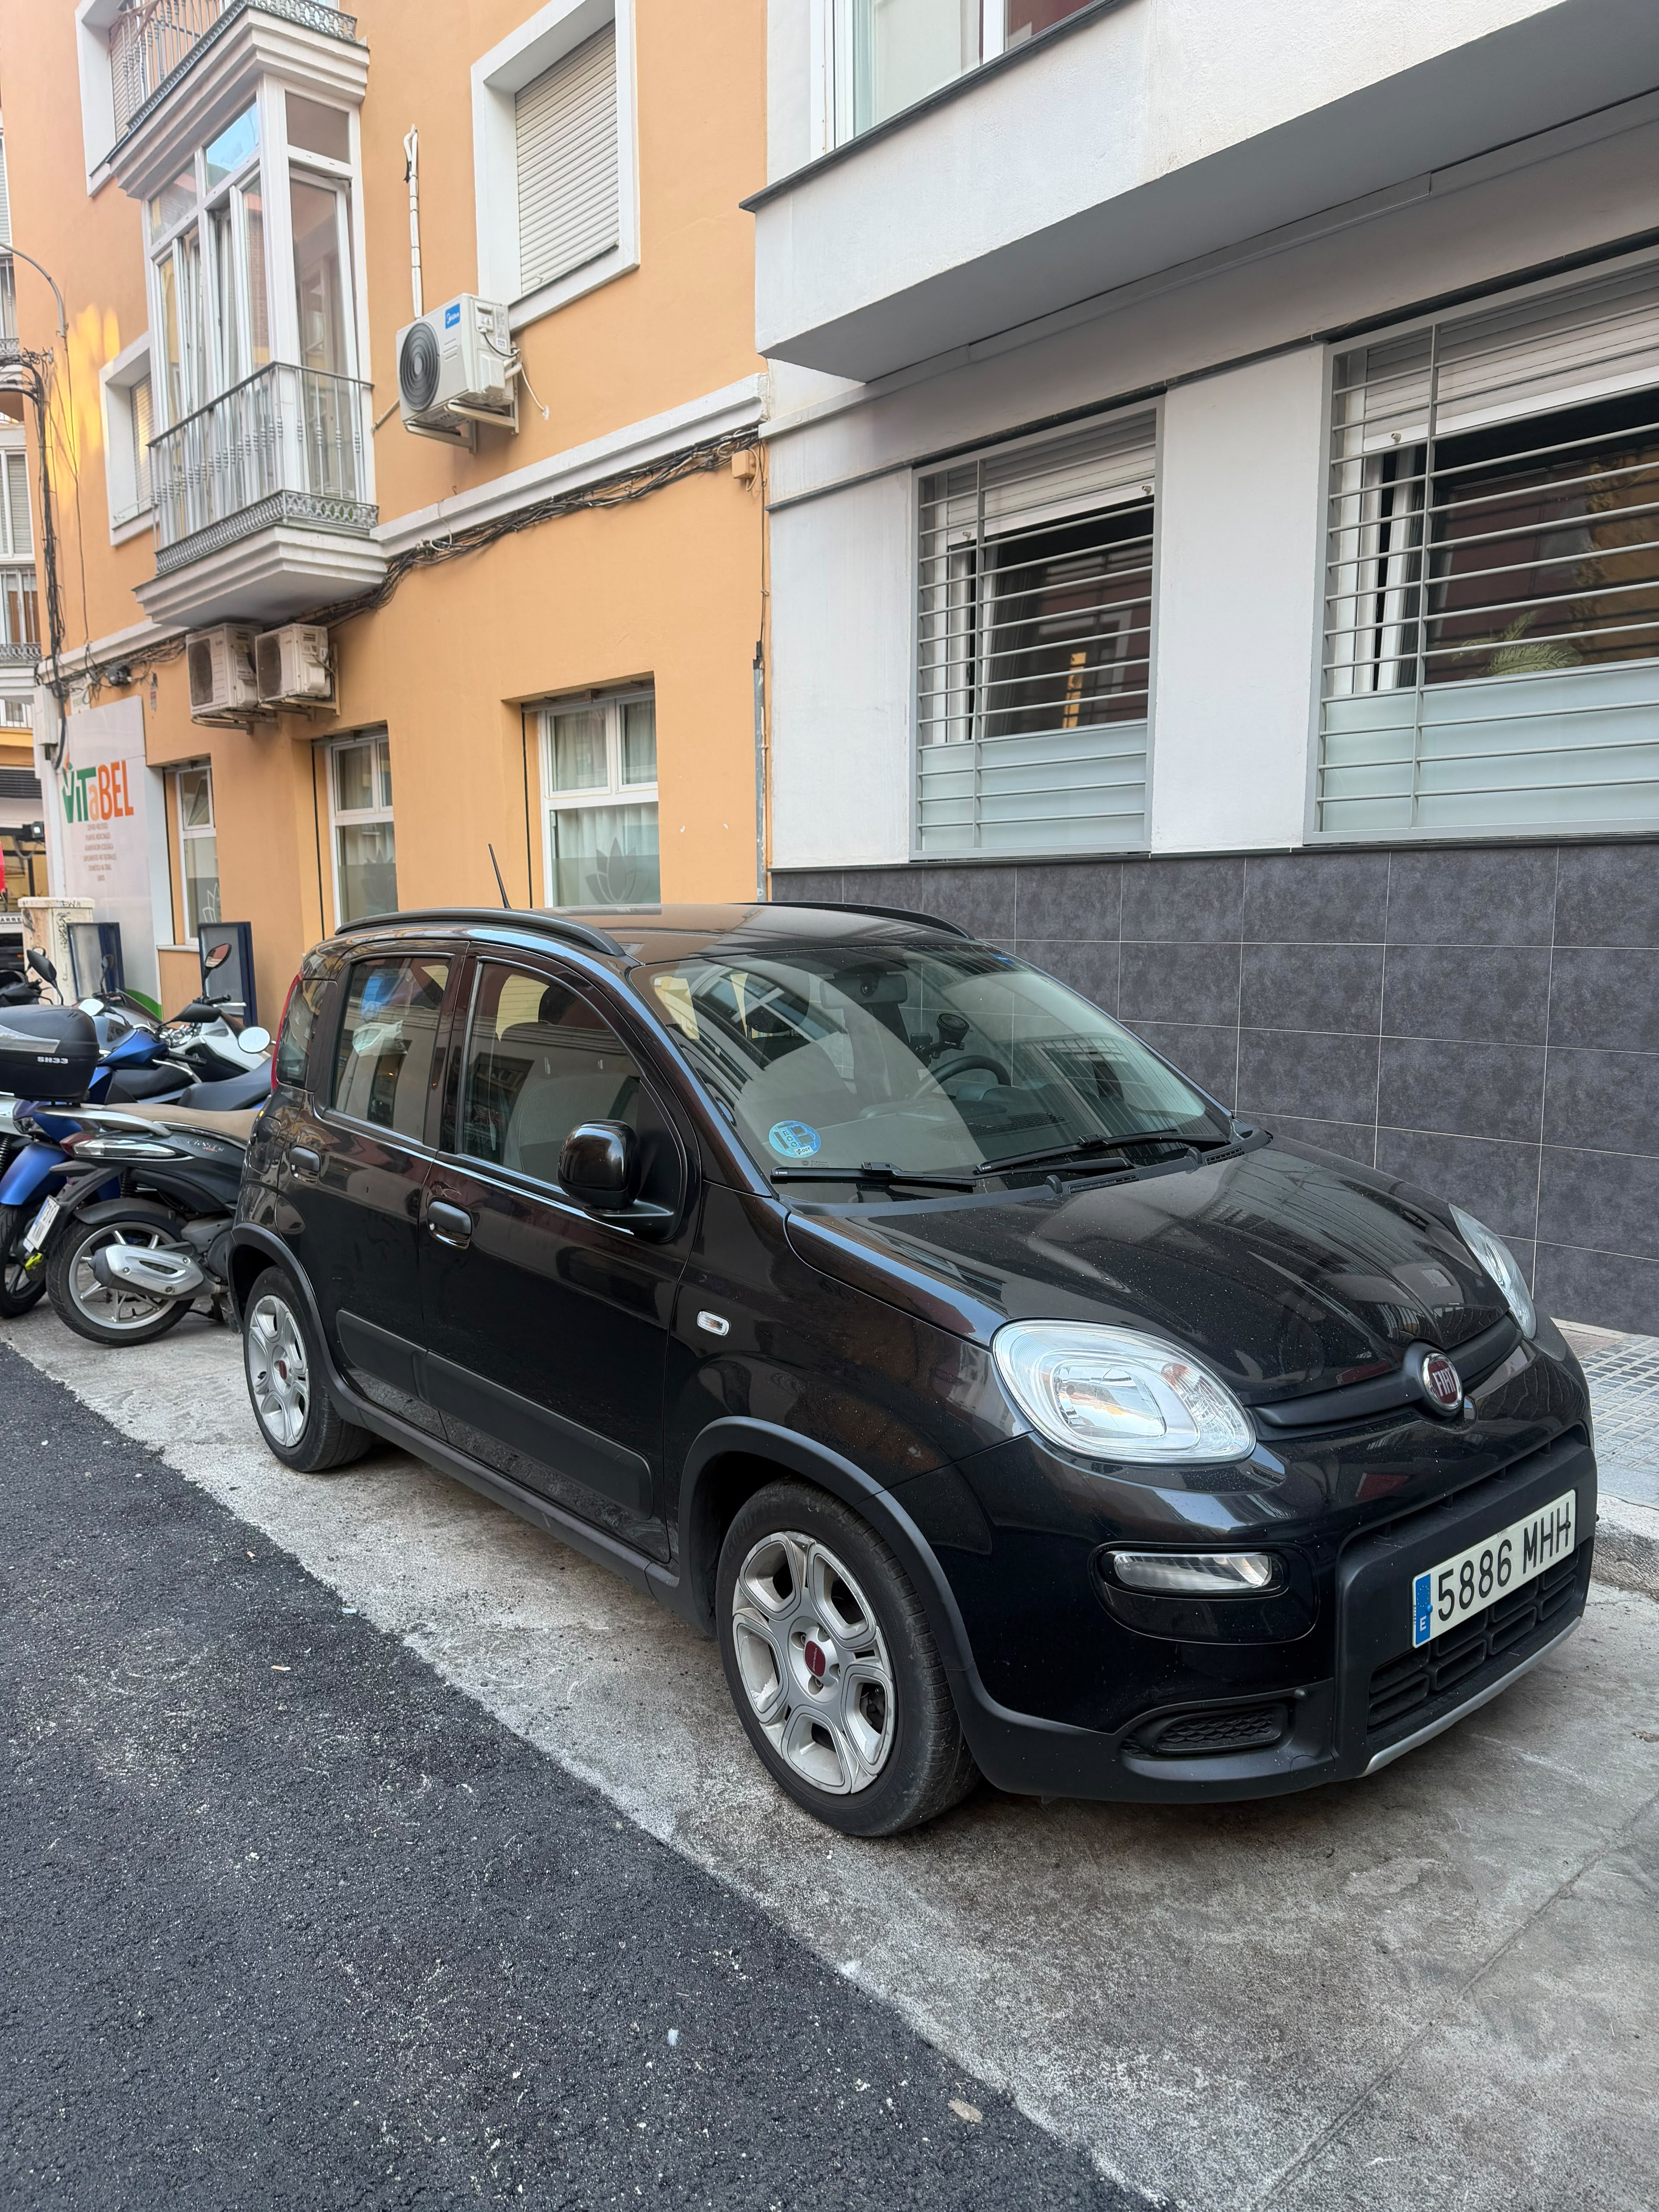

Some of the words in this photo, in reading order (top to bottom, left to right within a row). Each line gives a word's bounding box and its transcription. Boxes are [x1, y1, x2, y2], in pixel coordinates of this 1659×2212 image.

[37, 1056, 69, 1065] SH33
[782, 1130, 798, 1147] ECO
[1432, 1367, 1456, 1397] FIAT
[1438, 1539, 1512, 1621] 5886
[1523, 1502, 1570, 1575] MHH
[1419, 1615, 1427, 1632] E
